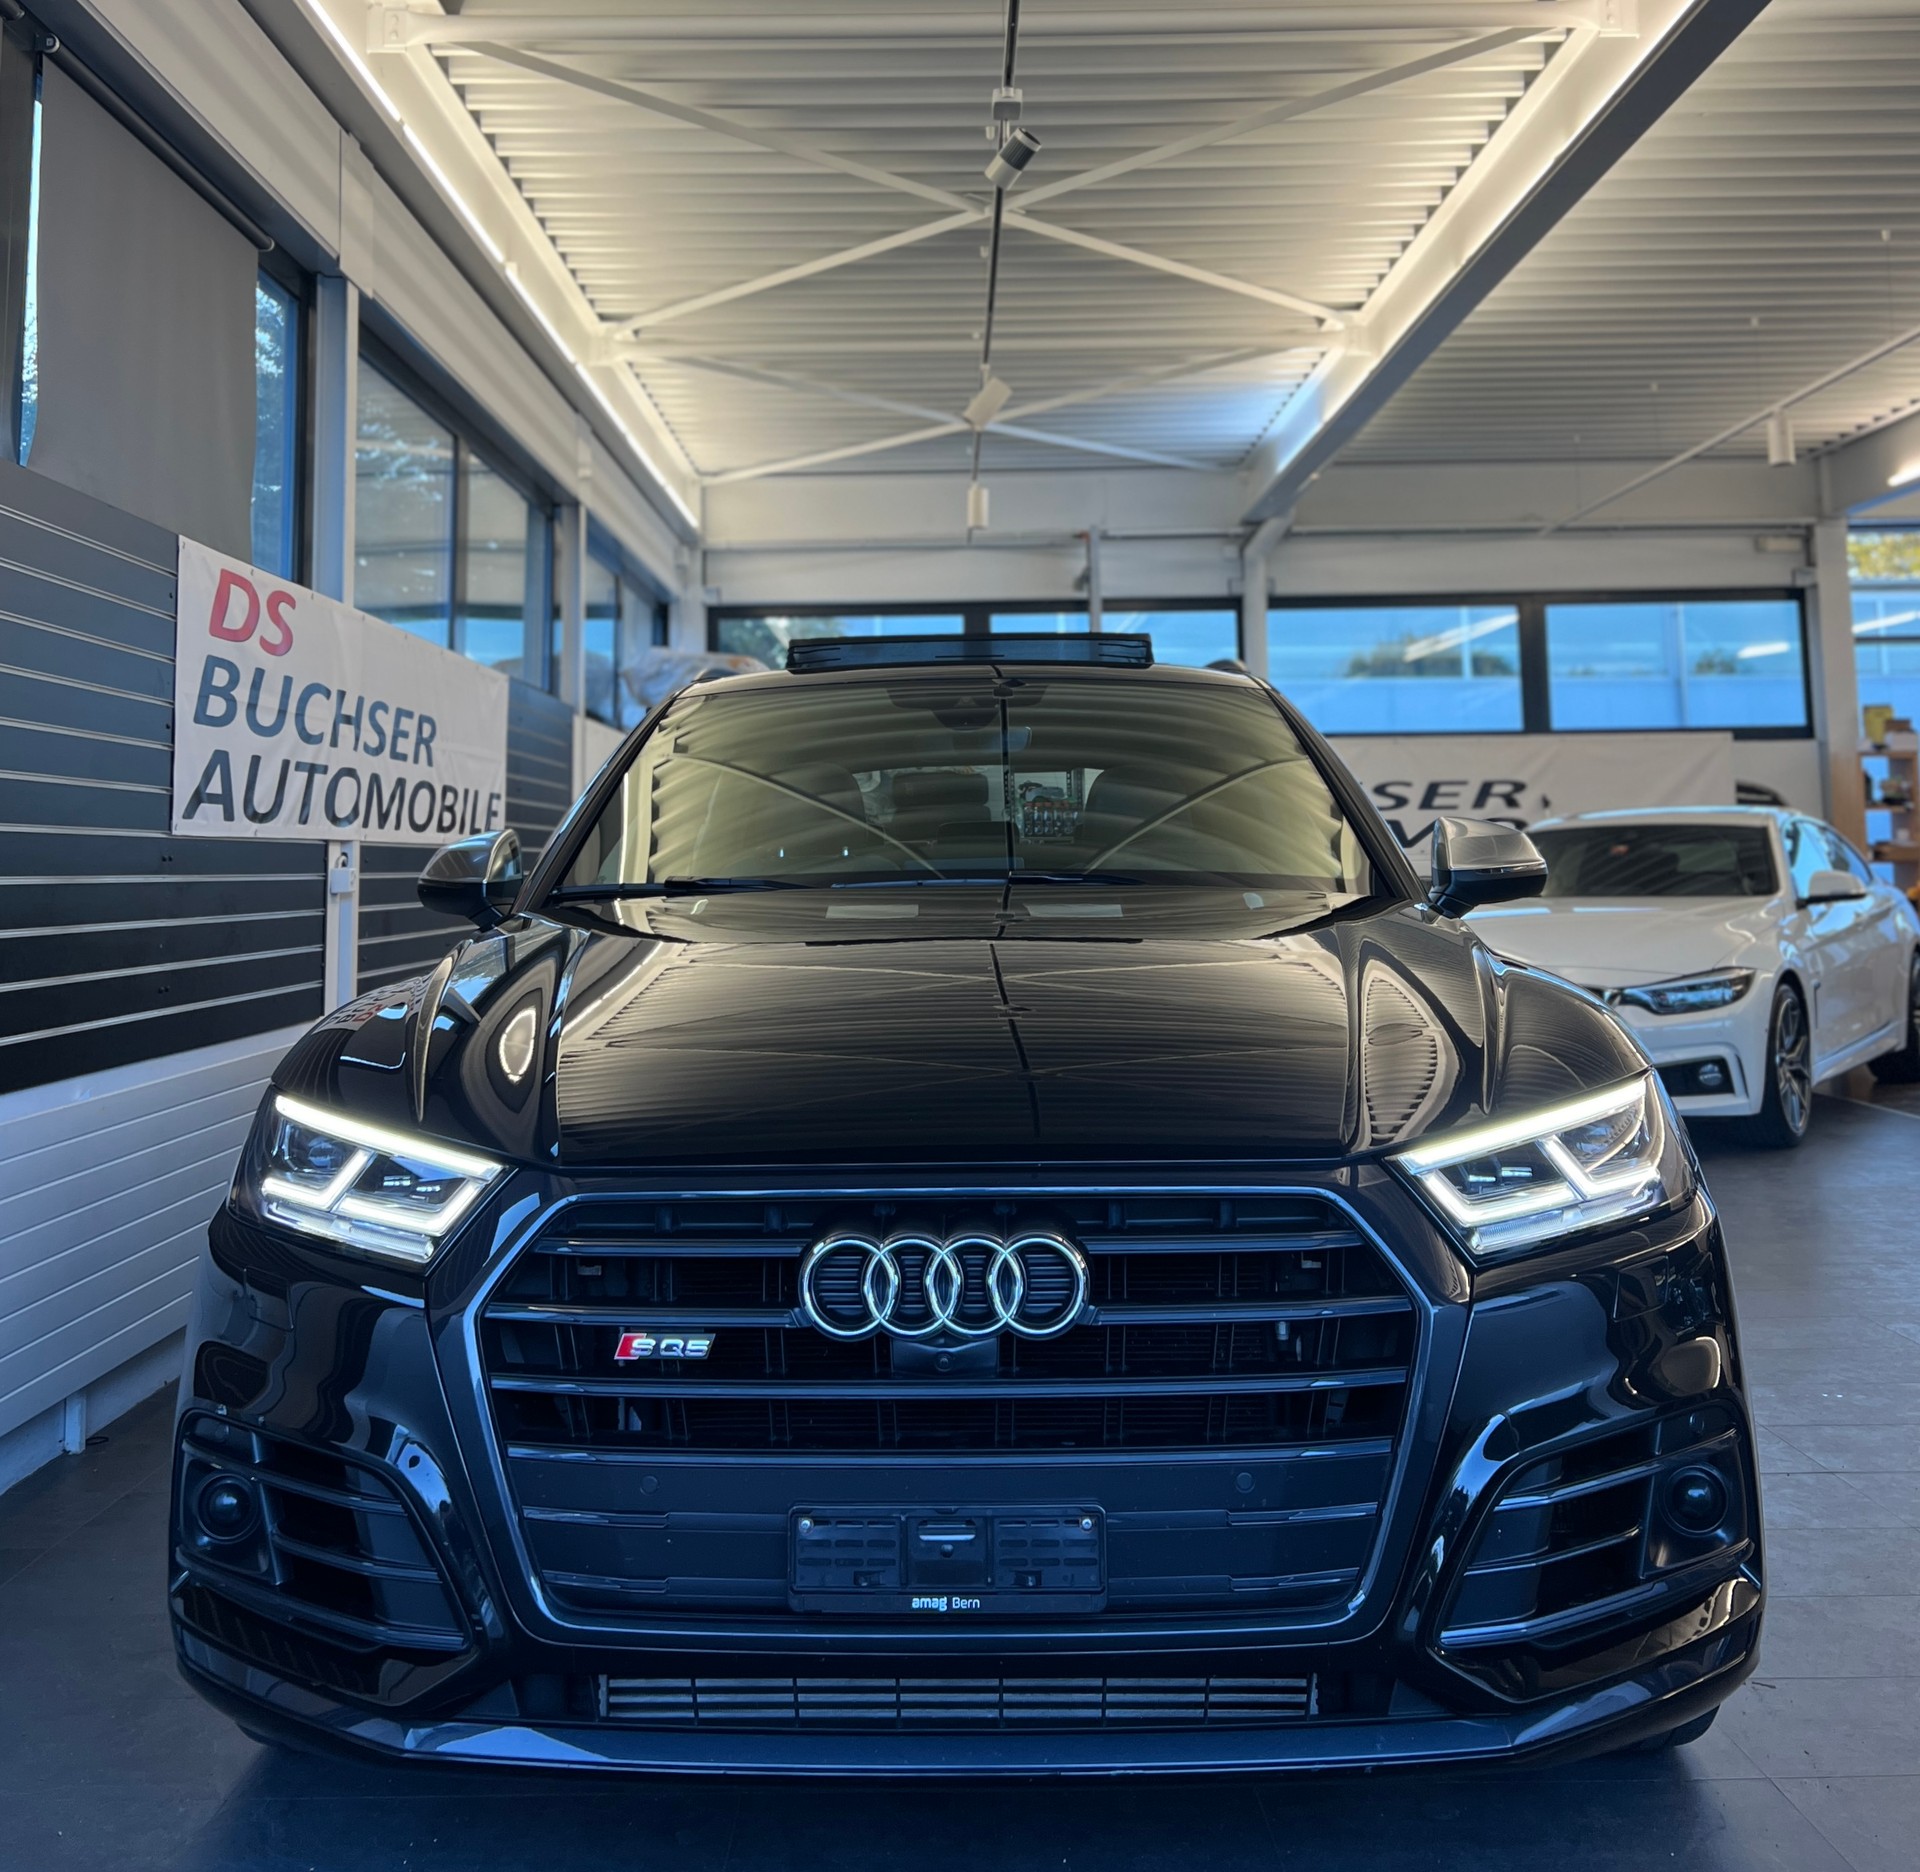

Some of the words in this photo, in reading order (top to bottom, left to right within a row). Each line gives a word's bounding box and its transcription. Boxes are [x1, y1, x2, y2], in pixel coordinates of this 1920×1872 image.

[209, 568, 296, 656] DS
[193, 654, 437, 767] BUCHSER
[912, 1596, 947, 1611] amag
[952, 1597, 980, 1609] Bern
